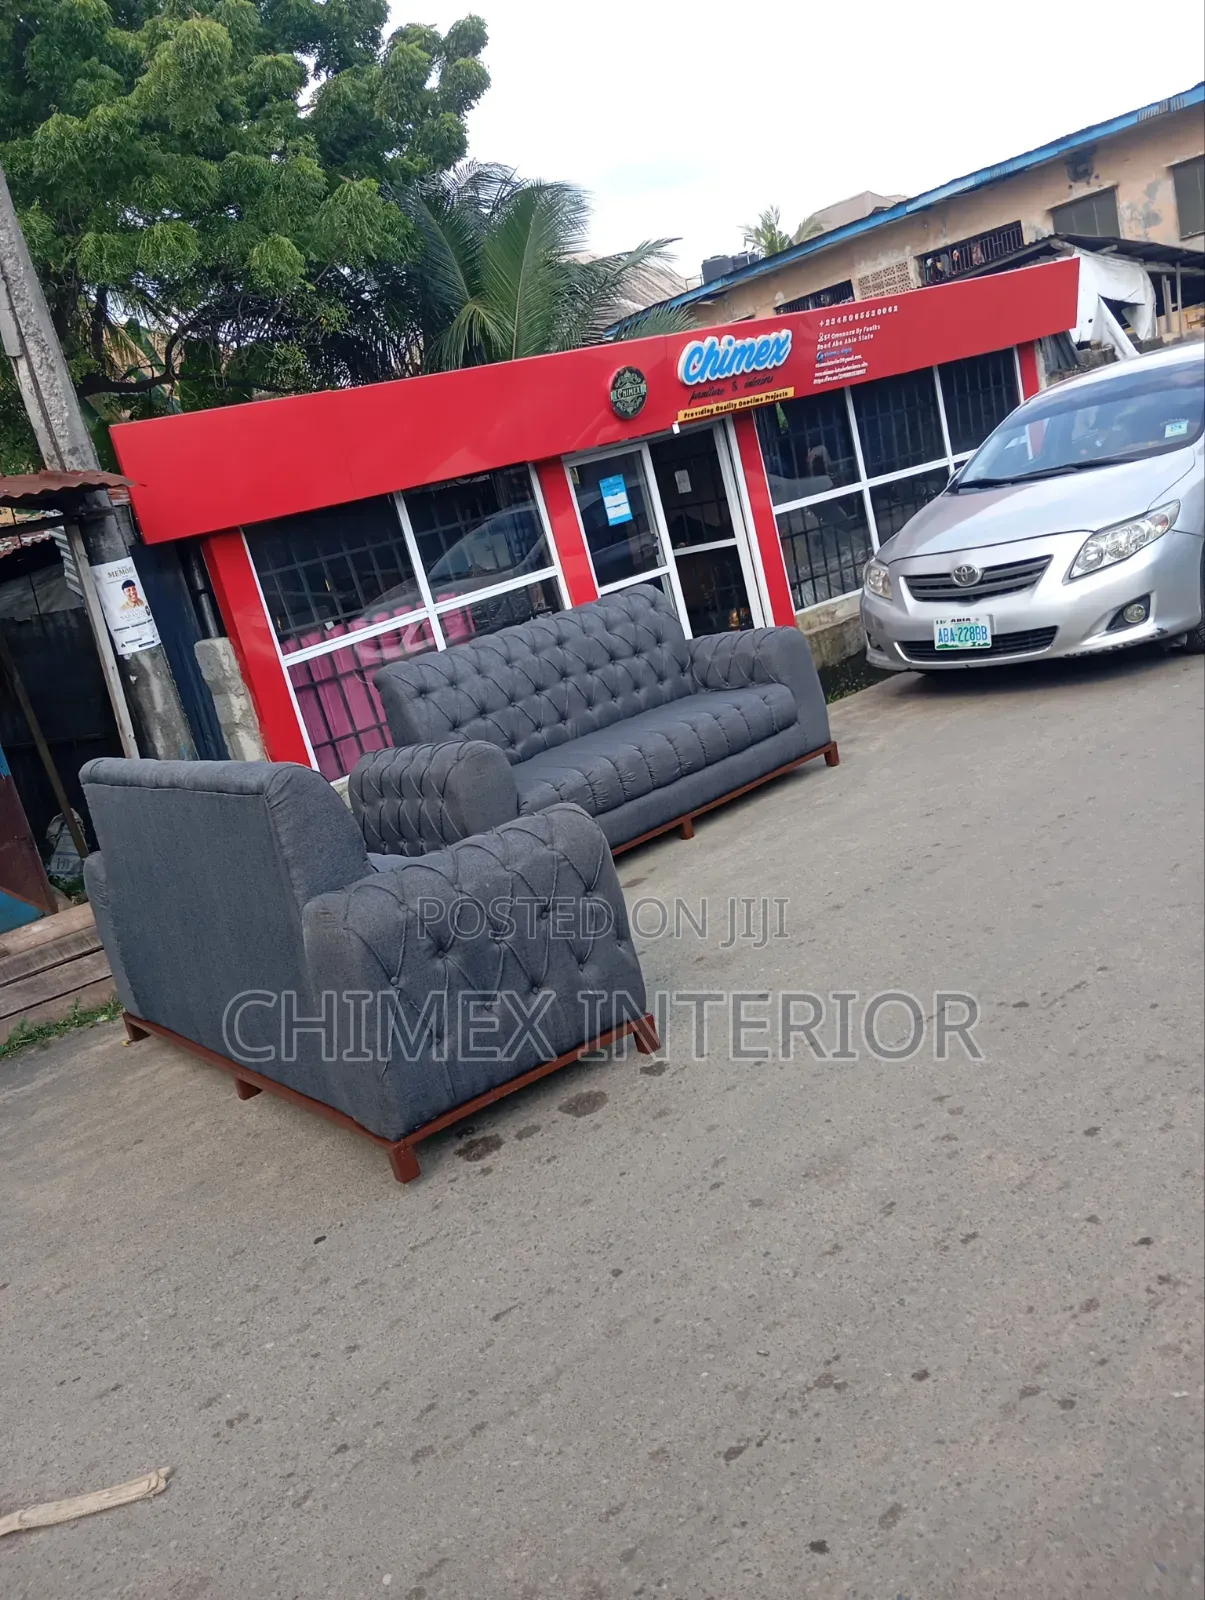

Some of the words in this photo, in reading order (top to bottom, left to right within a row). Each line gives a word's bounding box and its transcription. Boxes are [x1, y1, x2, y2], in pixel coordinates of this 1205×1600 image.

[817, 342, 831, 350] Road
[679, 330, 792, 384] Chimex
[732, 381, 738, 391] &
[684, 407, 714, 419] Providing
[715, 401, 737, 412] Quality
[765, 391, 788, 402] Projects
[938, 626, 987, 642] ABA-228BB
